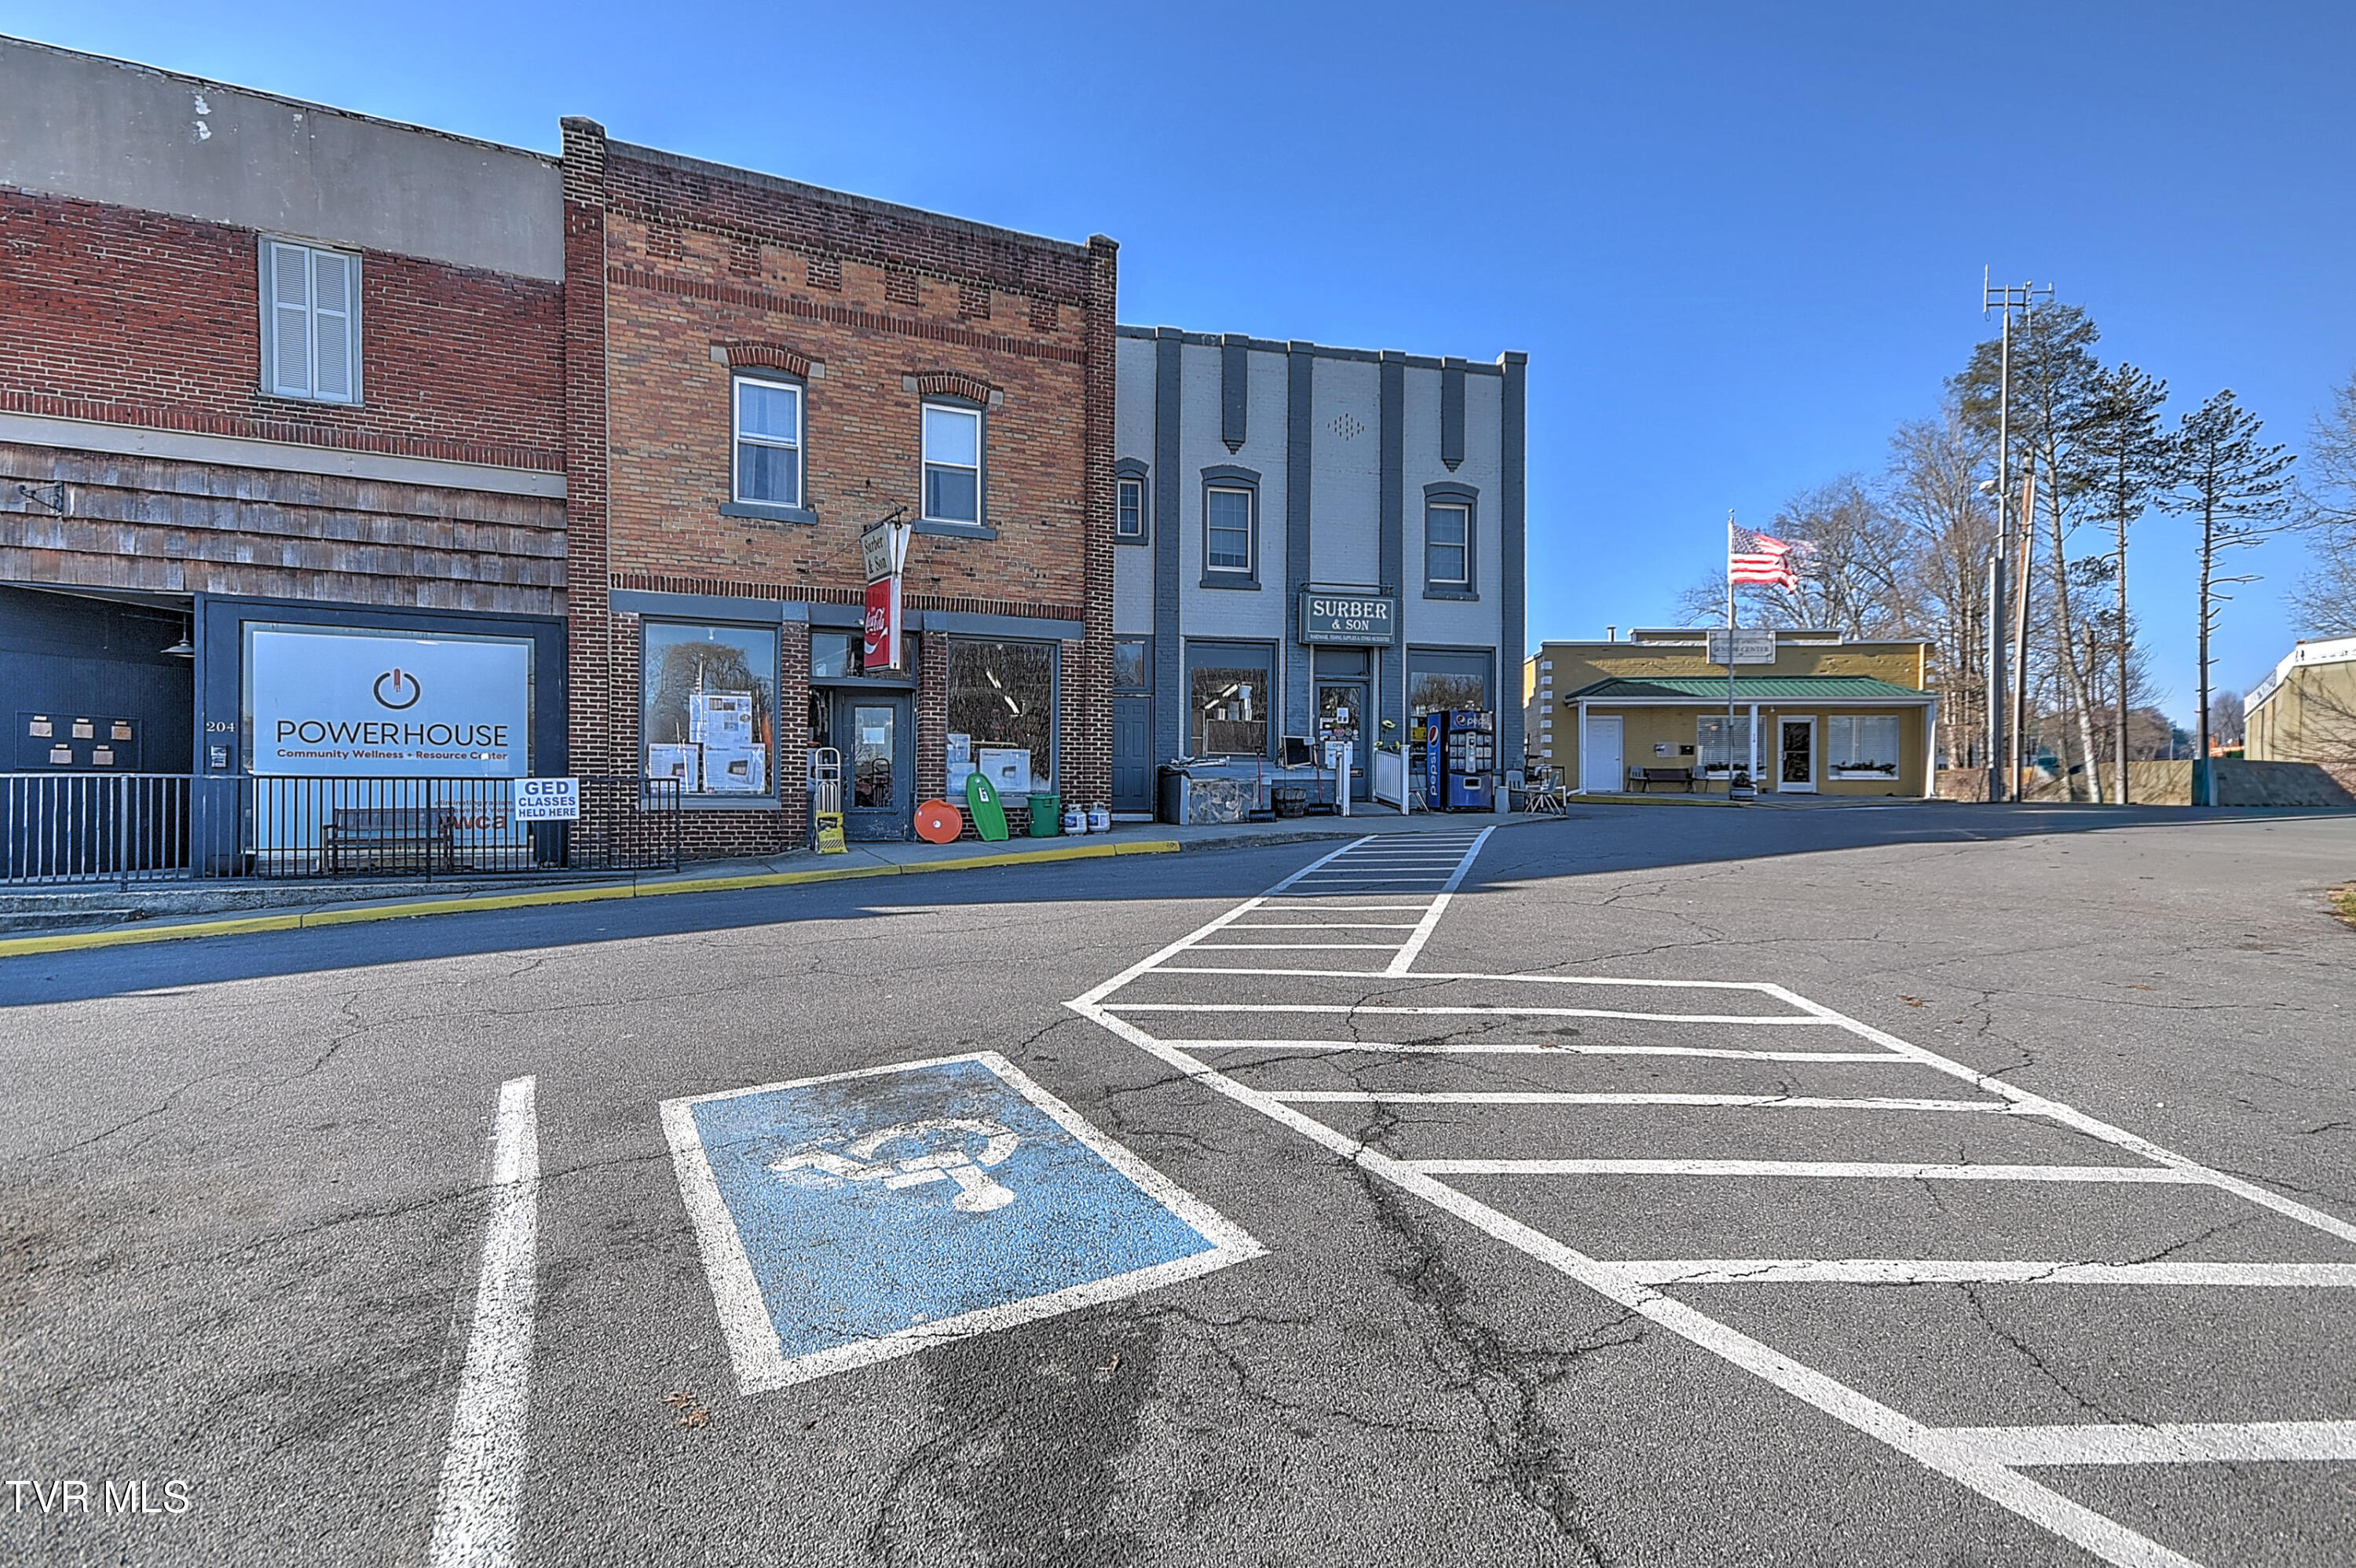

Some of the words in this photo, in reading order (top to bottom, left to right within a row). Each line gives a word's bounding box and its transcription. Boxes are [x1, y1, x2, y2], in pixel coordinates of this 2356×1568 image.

[864, 535, 884, 555] Surber
[868, 559, 874, 574] &
[874, 556, 887, 572] Son
[1313, 600, 1388, 620] SURBER
[1331, 619, 1341, 630] &
[1345, 619, 1370, 630] SON
[206, 722, 236, 733] 204
[277, 720, 508, 747] POWERHOUSE
[277, 749, 349, 760] Community
[353, 750, 404, 759] Wellness
[416, 751, 467, 760] Resource
[470, 751, 507, 760] Cnter
[1430, 752, 1439, 796] pepsi
[525, 781, 569, 795] GED
[518, 796, 576, 807] CLASSES
[518, 808, 546, 817] HELD
[549, 807, 576, 817] HERE
[444, 815, 506, 832] wca
